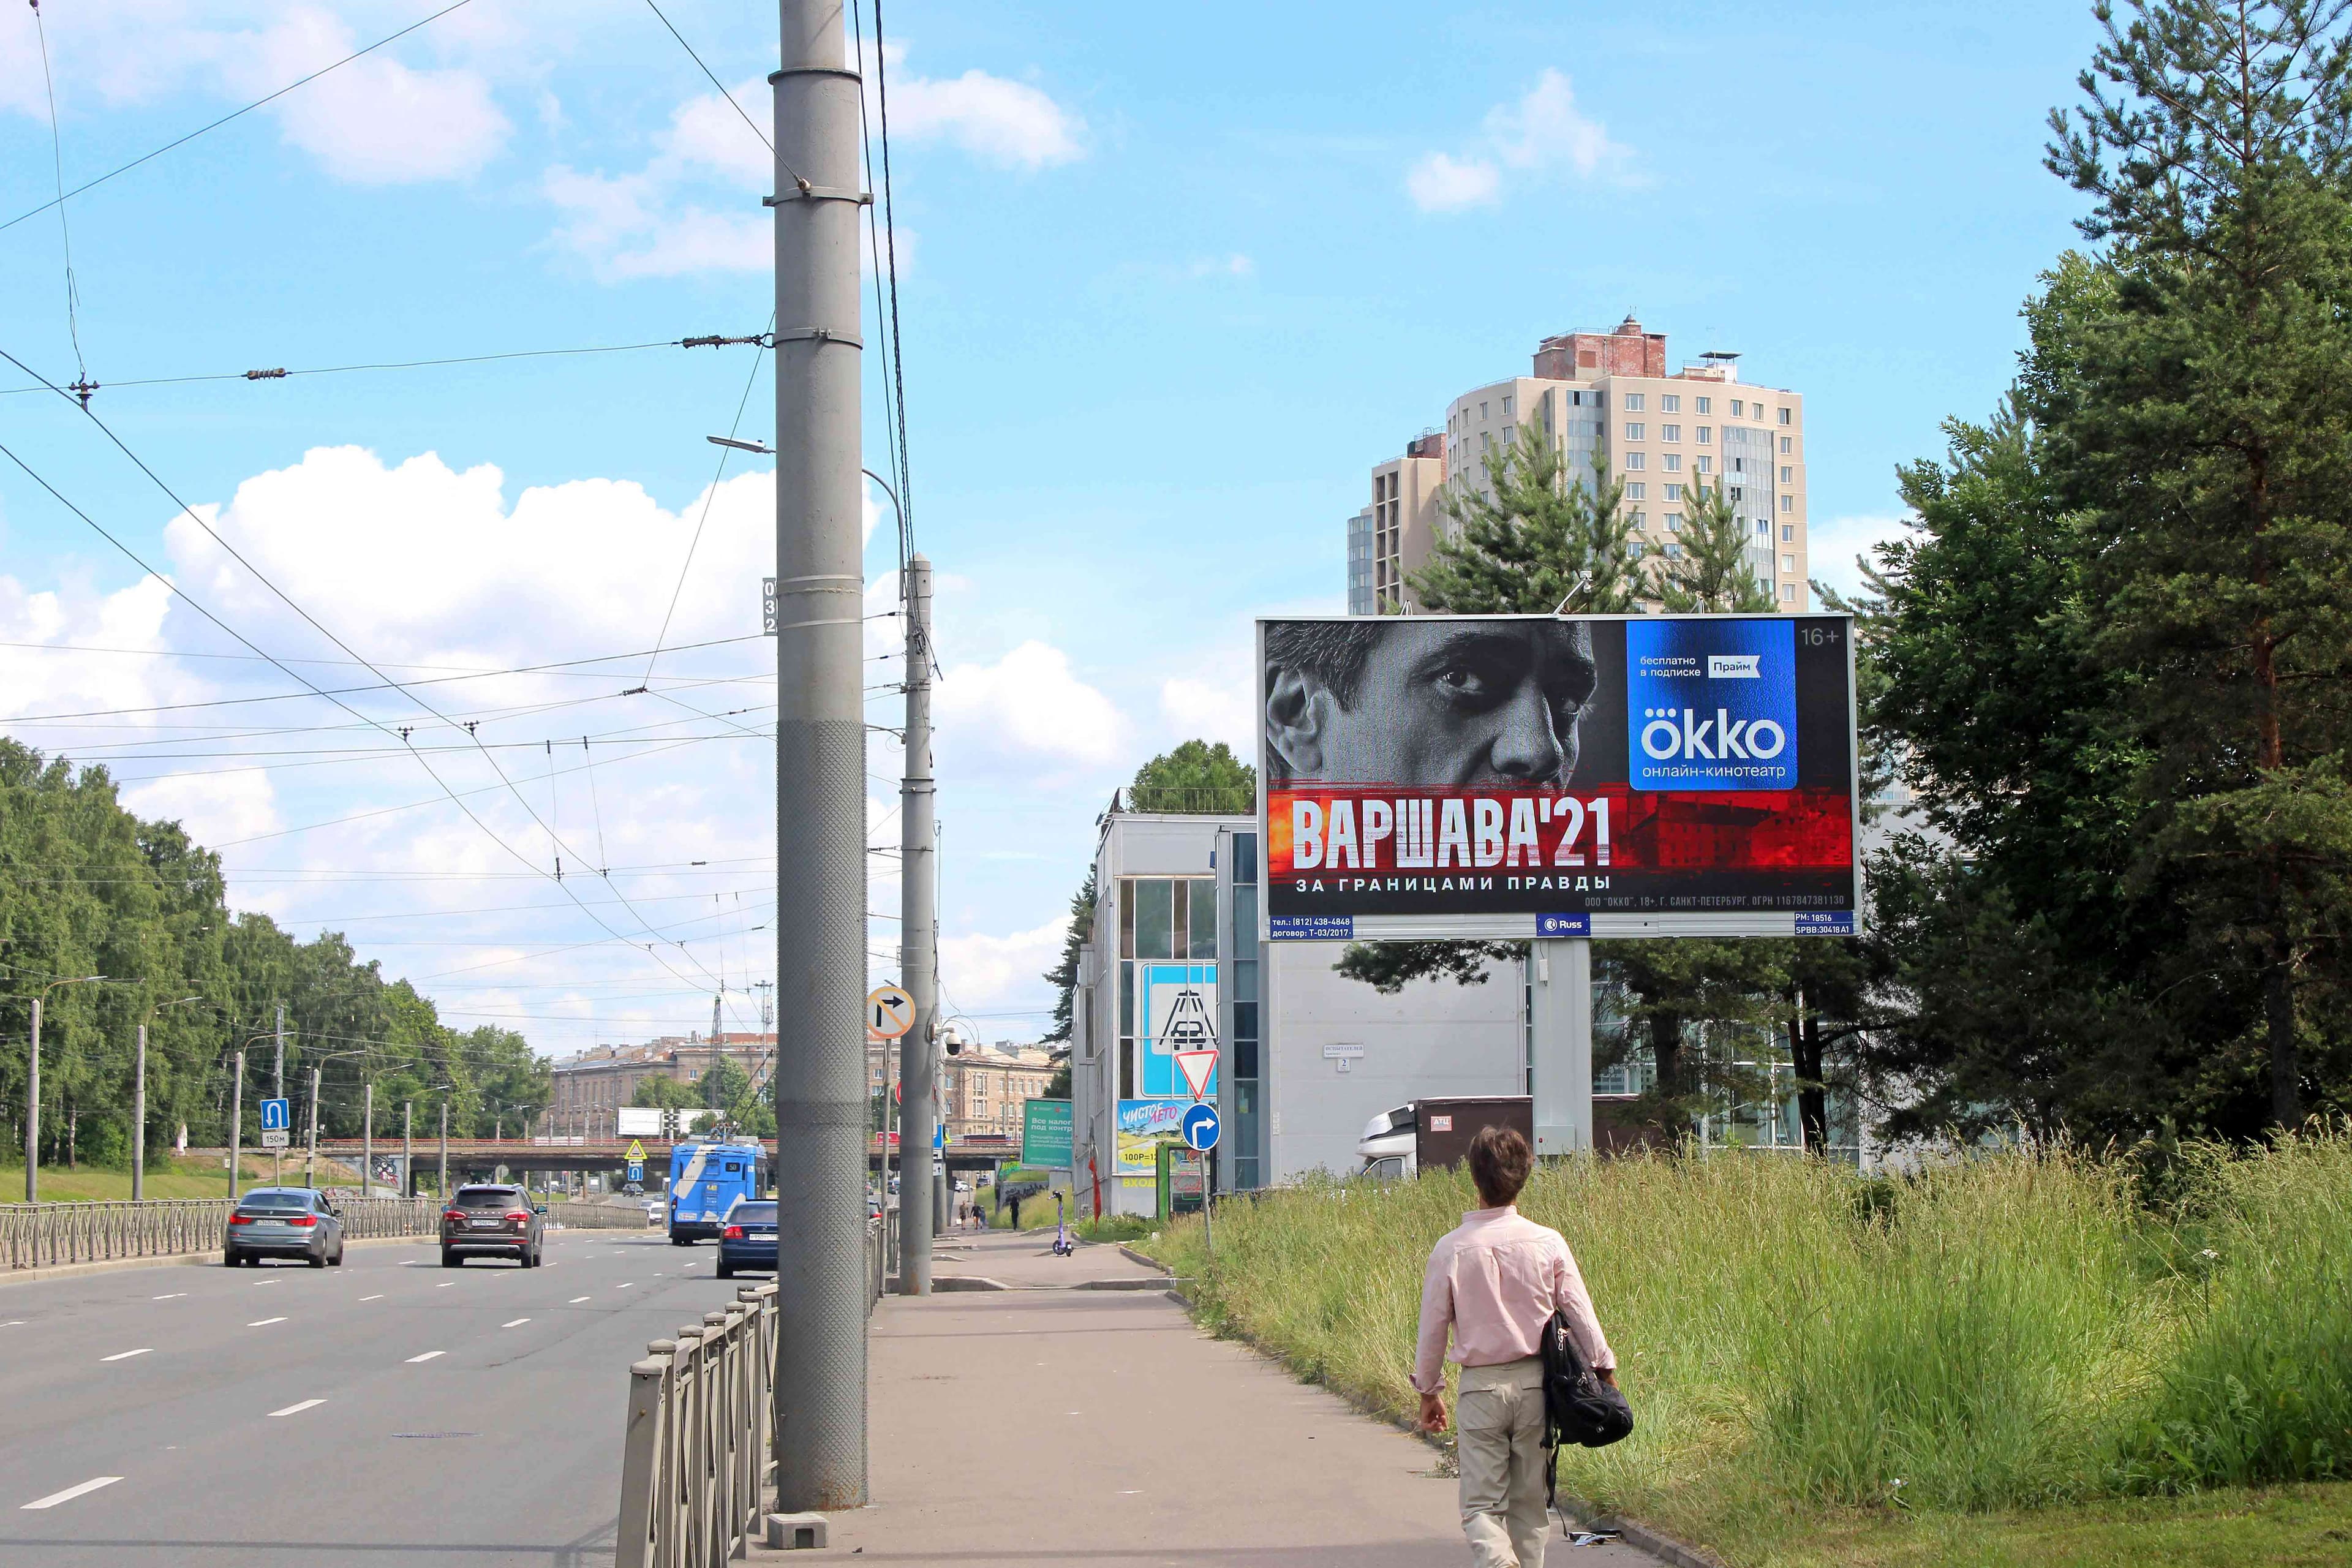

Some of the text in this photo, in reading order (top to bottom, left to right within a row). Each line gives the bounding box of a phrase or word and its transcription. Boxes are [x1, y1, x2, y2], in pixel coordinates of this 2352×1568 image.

[764, 581, 775, 633] 032
[1801, 628, 1839, 646] 16+
[1640, 655, 1696, 665] бесплатно
[1650, 668, 1701, 678] подписке
[1713, 661, 1751, 673] Прайм
[1642, 765, 1786, 779] онлайн-кинотеатр
[1292, 796, 1610, 869] ВАРШАВА'21
[1295, 876, 1610, 893] ЗА ГРАНИЦАМИ ПРАВДЫ
[1585, 897, 1601, 907] ООО
[1752, 895, 1773, 905] ОГРН
[1776, 895, 1844, 905] 1167847381130
[1292, 918, 1313, 926] (812)
[1559, 918, 1582, 929] Russ
[1308, 929, 1349, 937] Т-03/2017
[1342, 1058, 1347, 1067] 2
[1147, 1106, 1178, 1125] ЛЕТО
